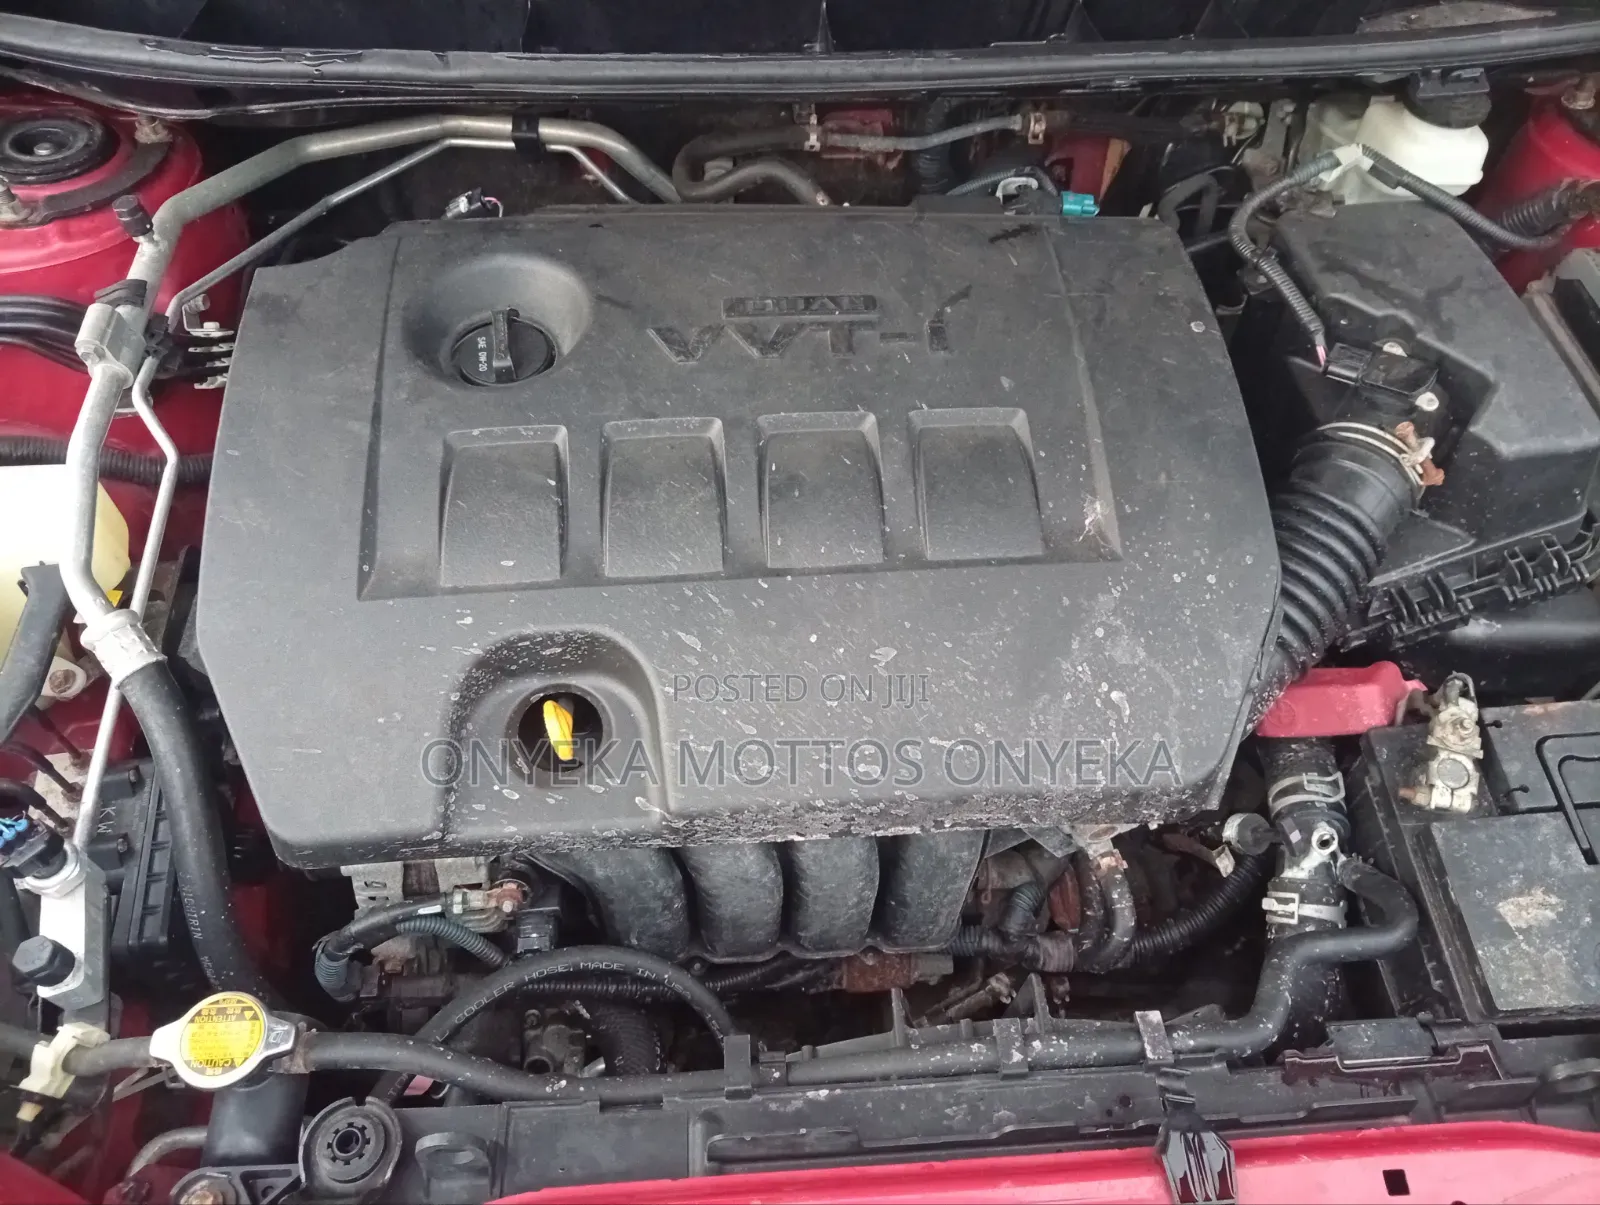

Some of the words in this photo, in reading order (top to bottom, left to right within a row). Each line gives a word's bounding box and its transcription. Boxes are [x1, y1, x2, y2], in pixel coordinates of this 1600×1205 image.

[477, 336, 487, 349] SAE
[454, 980, 516, 1024] COOLER
[579, 961, 626, 972] MADE
[636, 967, 656, 980] IN
[194, 1014, 236, 1023] ATTENTION
[190, 1057, 231, 1068] CAUTION
